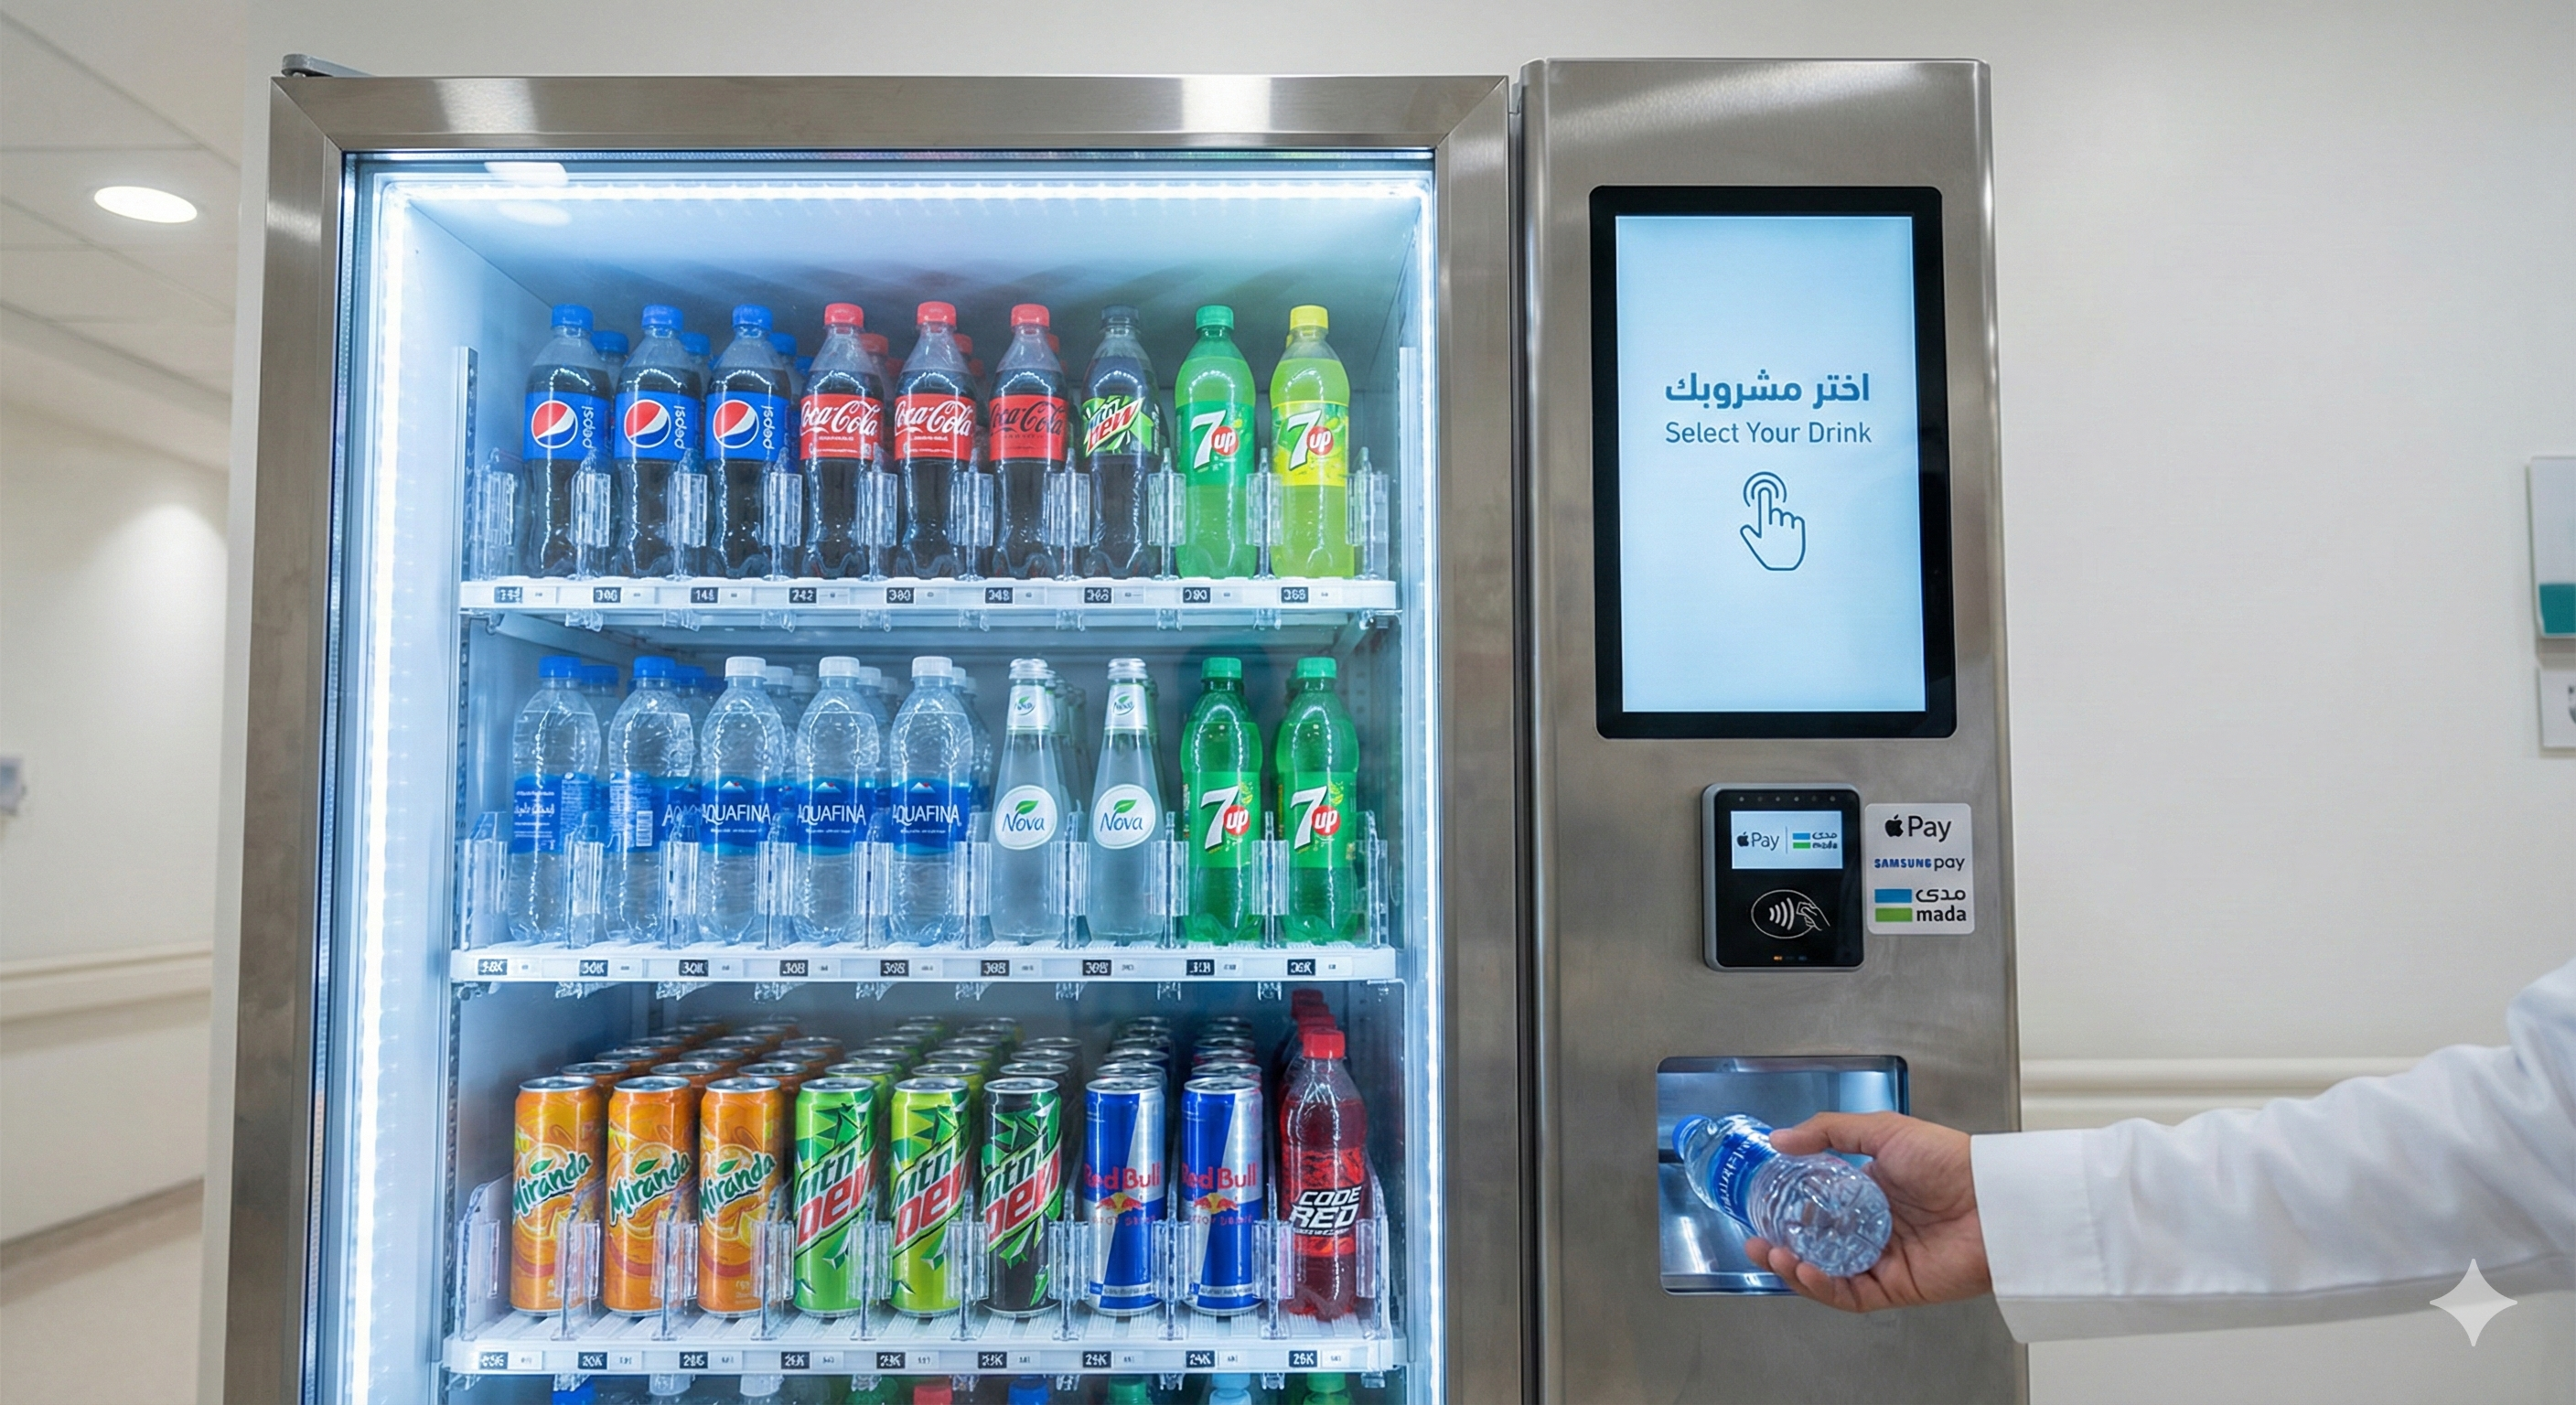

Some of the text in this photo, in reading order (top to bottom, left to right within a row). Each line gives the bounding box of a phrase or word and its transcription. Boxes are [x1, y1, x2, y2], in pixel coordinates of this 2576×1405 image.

[1665, 369, 1869, 410] اختر مشروبك
[581, 405, 595, 449] pepsi
[673, 405, 686, 449] pepsi
[760, 405, 774, 449] pepsi
[800, 401, 881, 436] Coca-Cola
[895, 401, 973, 436] Coca-Cola
[1665, 422, 1872, 443] Select Your Drink
[1003, 810, 1045, 831] Nova
[1100, 810, 1143, 831] Nova
[1907, 815, 1952, 842] Pay
[1751, 831, 1780, 851] Pay
[1874, 857, 1966, 871] SAMSUNG pay
[1916, 888, 1967, 903] مدى
[1916, 906, 1967, 922] mada
[513, 1151, 592, 1221] Miranda
[611, 1152, 691, 1225] Miranda
[700, 1153, 777, 1224] Miranda
[1122, 1162, 1161, 1189] Bull
[1218, 1162, 1257, 1189] Bull
[1298, 1185, 1362, 1207] CODE
[1288, 1203, 1359, 1228] RED
